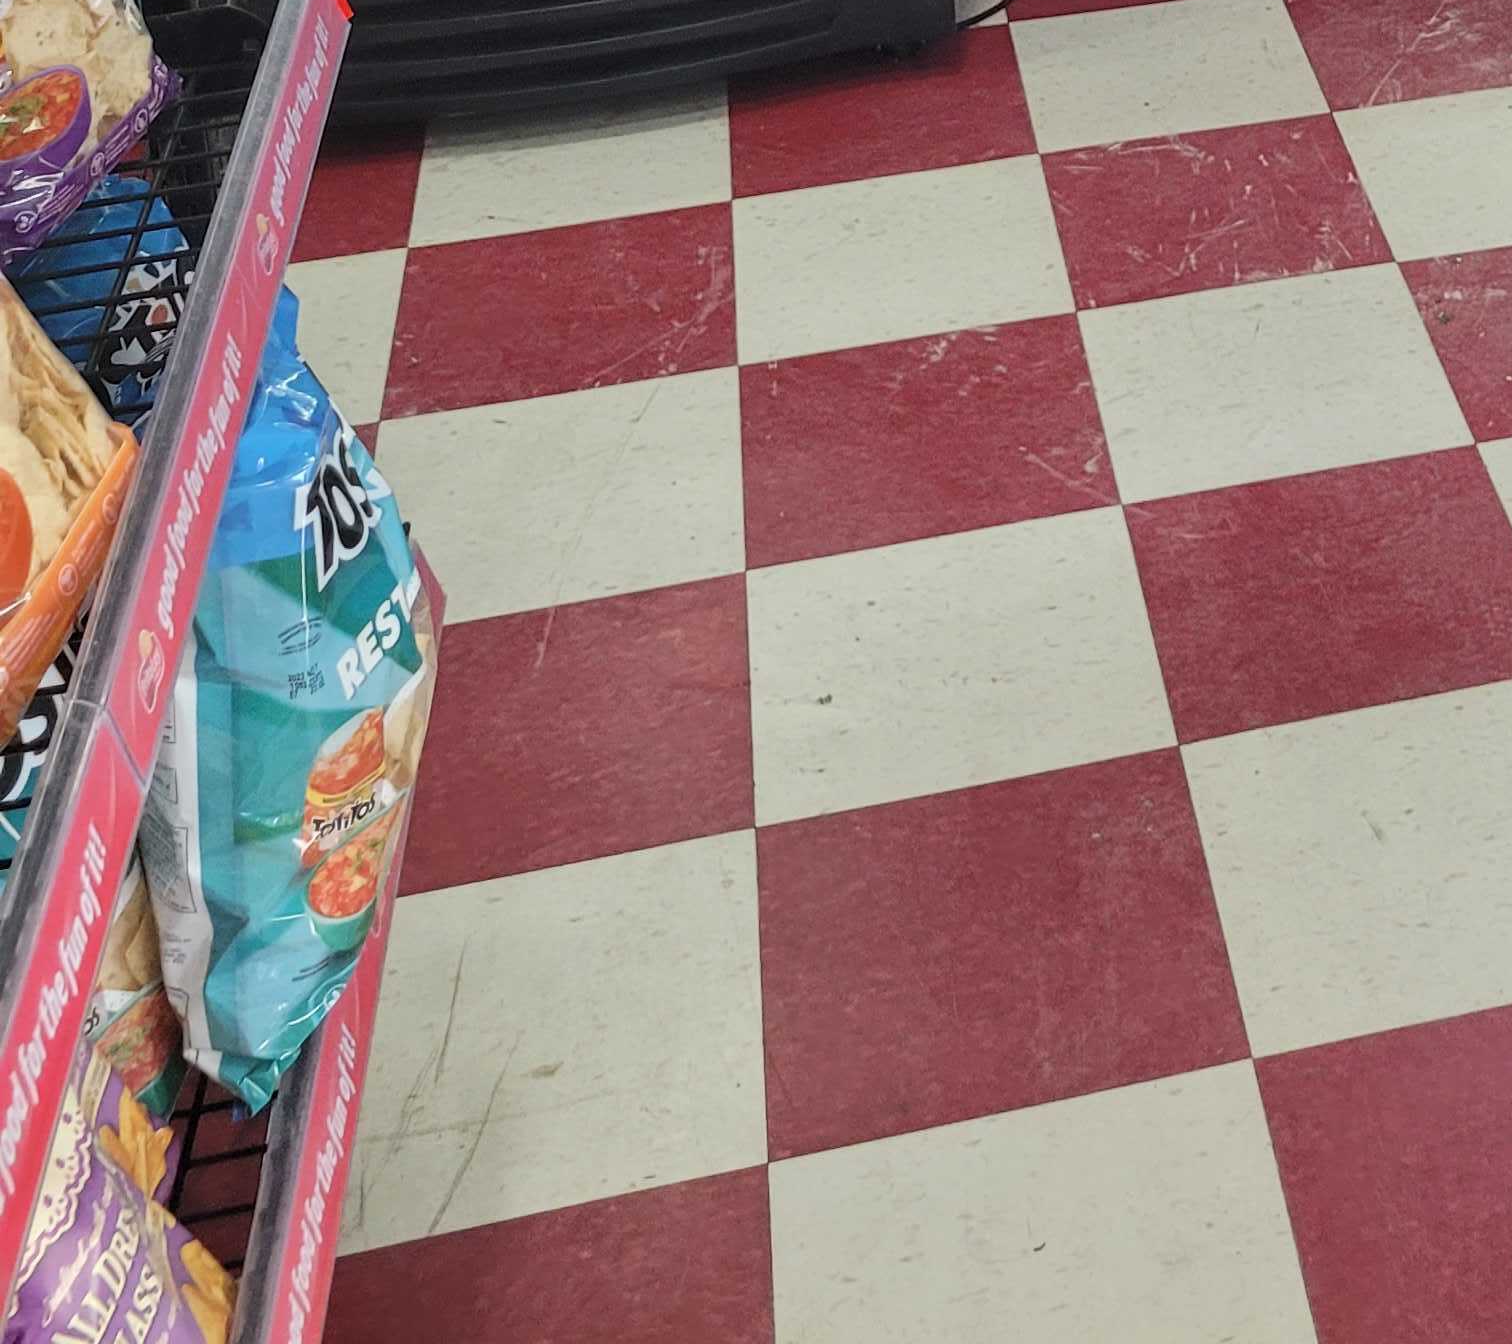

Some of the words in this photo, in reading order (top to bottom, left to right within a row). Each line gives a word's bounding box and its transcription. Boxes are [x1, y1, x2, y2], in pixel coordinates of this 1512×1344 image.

[277, 116, 296, 179] food
[270, 156, 287, 226] good
[157, 543, 179, 639] good
[169, 487, 193, 568] food
[185, 462, 205, 513] for
[197, 429, 220, 473] the
[210, 394, 231, 449] fun
[224, 330, 242, 377] it!
[83, 819, 105, 884] it!
[83, 863, 100, 924] of
[60, 915, 89, 996] fun
[37, 970, 68, 1039] the
[21, 1023, 47, 1105] for
[293, 1219, 317, 1311] food
[306, 1186, 325, 1243] for
[316, 1139, 338, 1192] the
[329, 1095, 348, 1157] fun
[340, 1022, 357, 1070] it!
